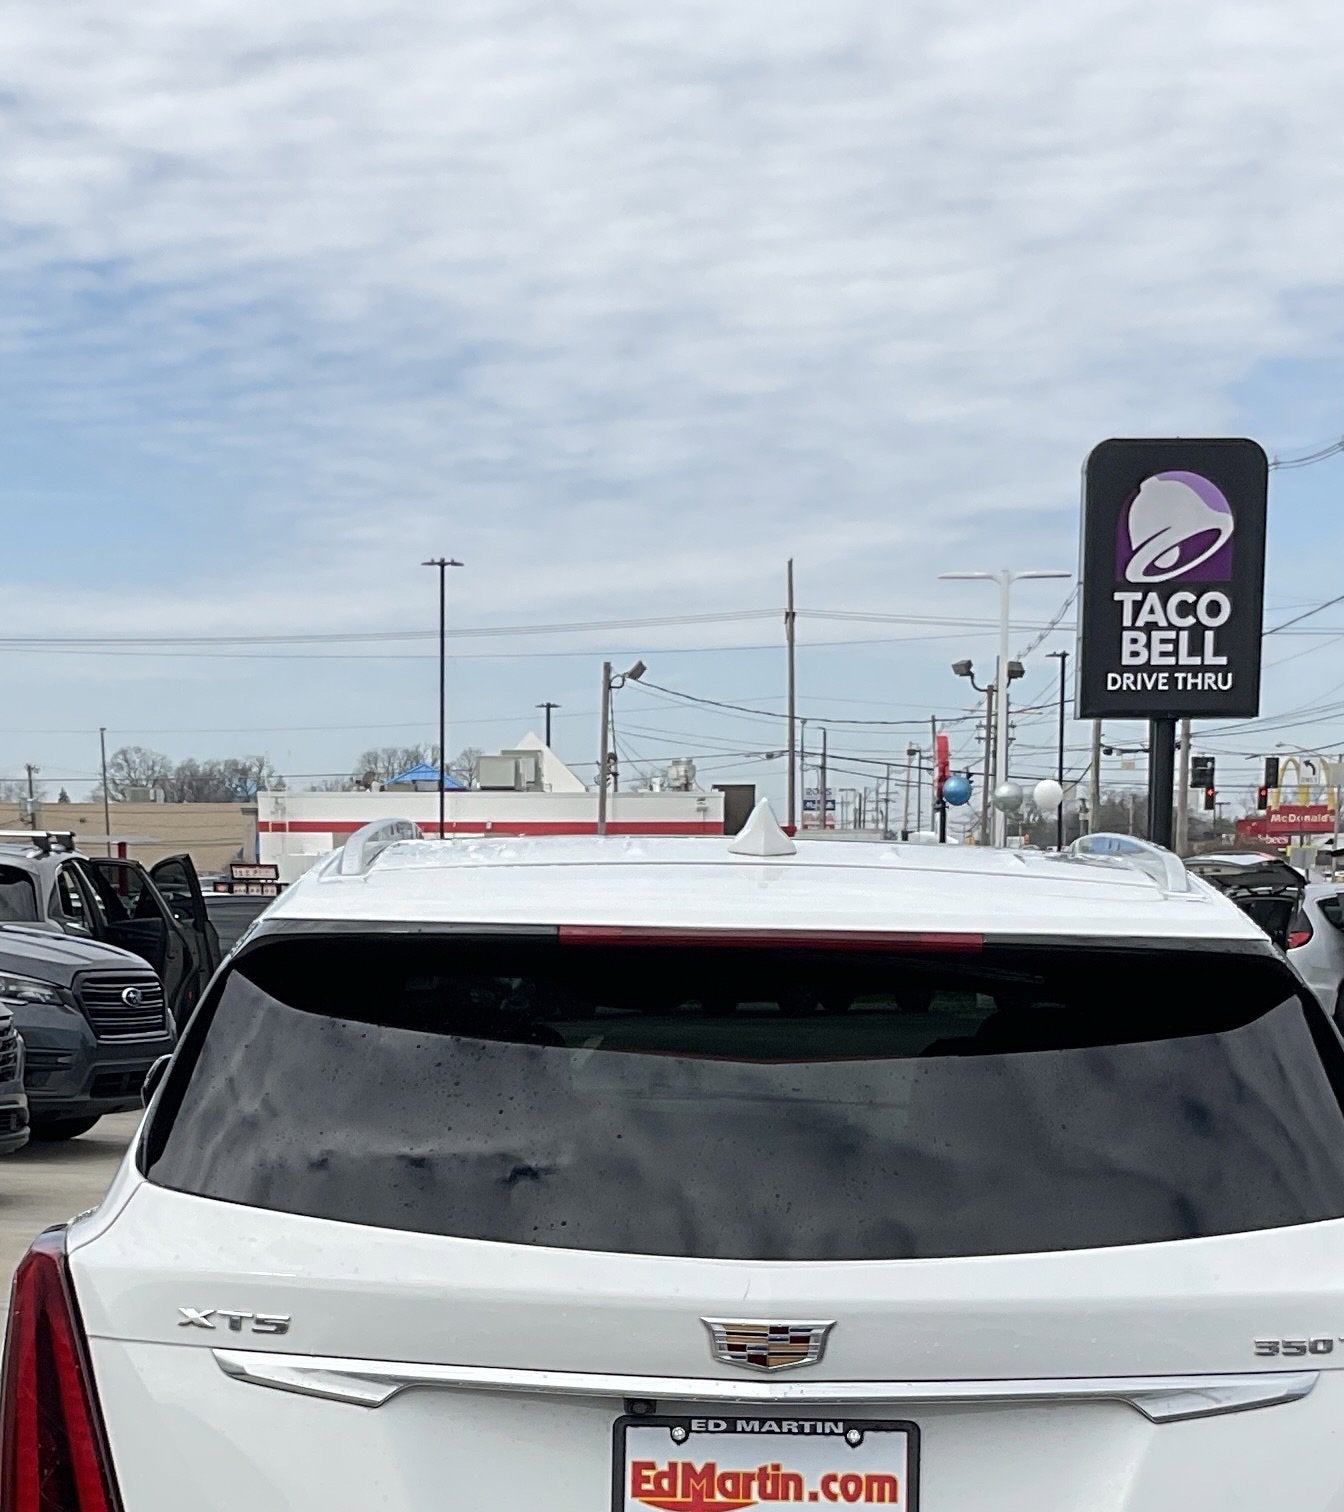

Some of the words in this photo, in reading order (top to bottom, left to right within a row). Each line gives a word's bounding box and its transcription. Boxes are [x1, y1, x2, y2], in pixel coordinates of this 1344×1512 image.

[1113, 591, 1232, 628] TACO
[1121, 630, 1228, 666] BELL
[1107, 672, 1169, 691] DRIVE
[1174, 672, 1233, 691] THRU
[177, 1307, 291, 1335] XT5
[691, 1419, 727, 1432] ED
[736, 1420, 845, 1434] MARTIN
[630, 1461, 899, 1504] EdMartin.com
